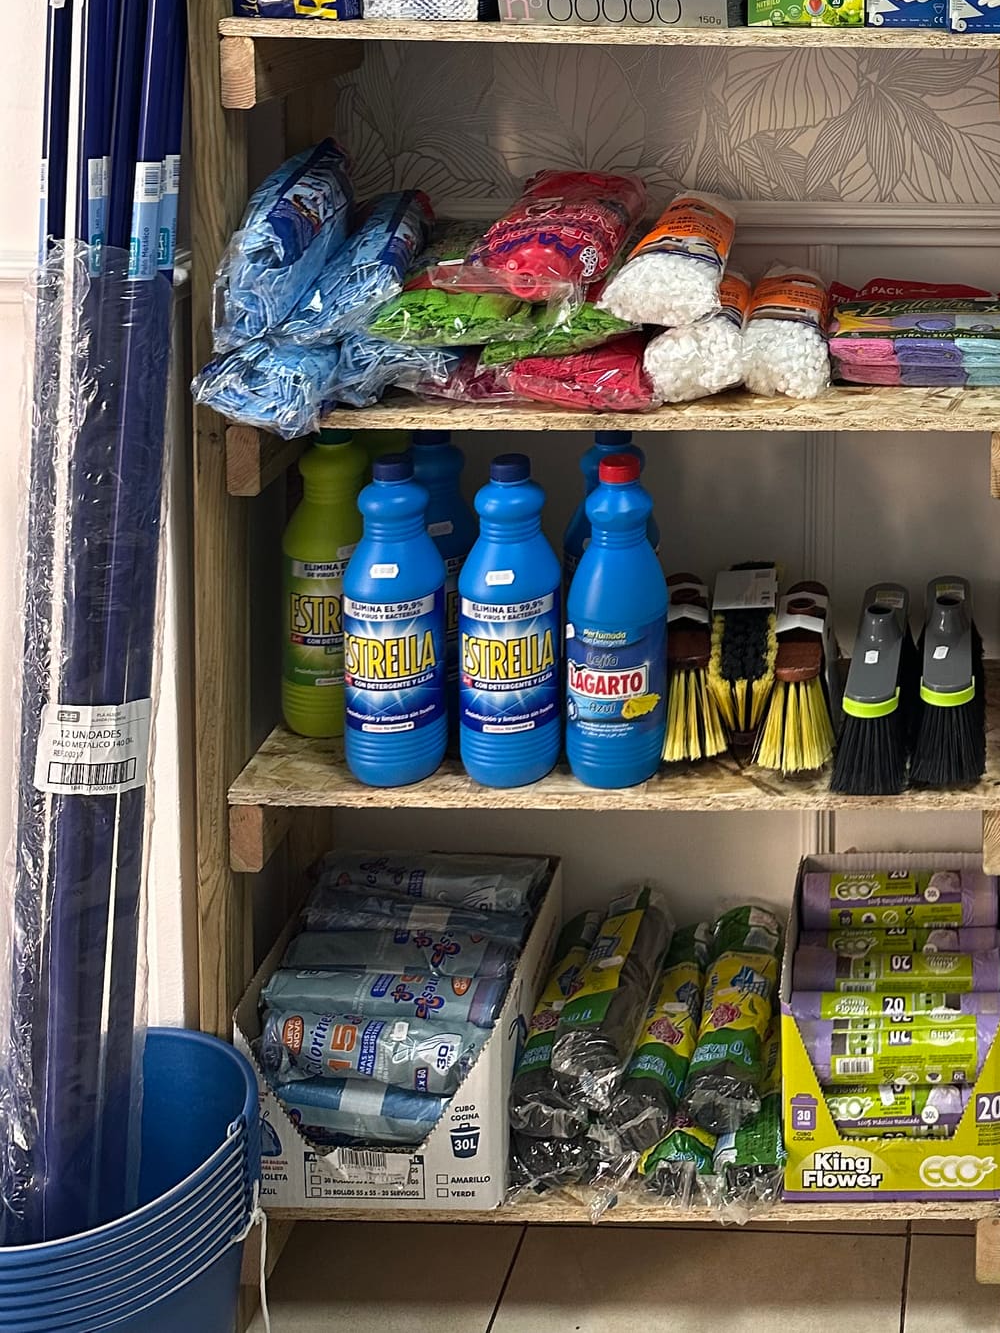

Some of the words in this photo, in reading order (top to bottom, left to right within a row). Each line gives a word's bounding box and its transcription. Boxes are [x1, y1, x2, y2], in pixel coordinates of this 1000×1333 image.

[351, 604, 381, 613] ELIMINA
[384, 603, 394, 611] EL
[472, 604, 503, 614] ELIMINA
[344, 631, 436, 681] ESTRELLA
[462, 630, 554, 681] ESTRELLA
[568, 667, 643, 694] LAGARTO
[72, 730, 121, 739] UNIDADES
[455, 1138, 476, 1150] 30L
[815, 1152, 869, 1172] King
[451, 1175, 490, 1184] AMARILLO
[803, 1170, 882, 1189] Flower
[451, 1189, 475, 1197] VERDE
